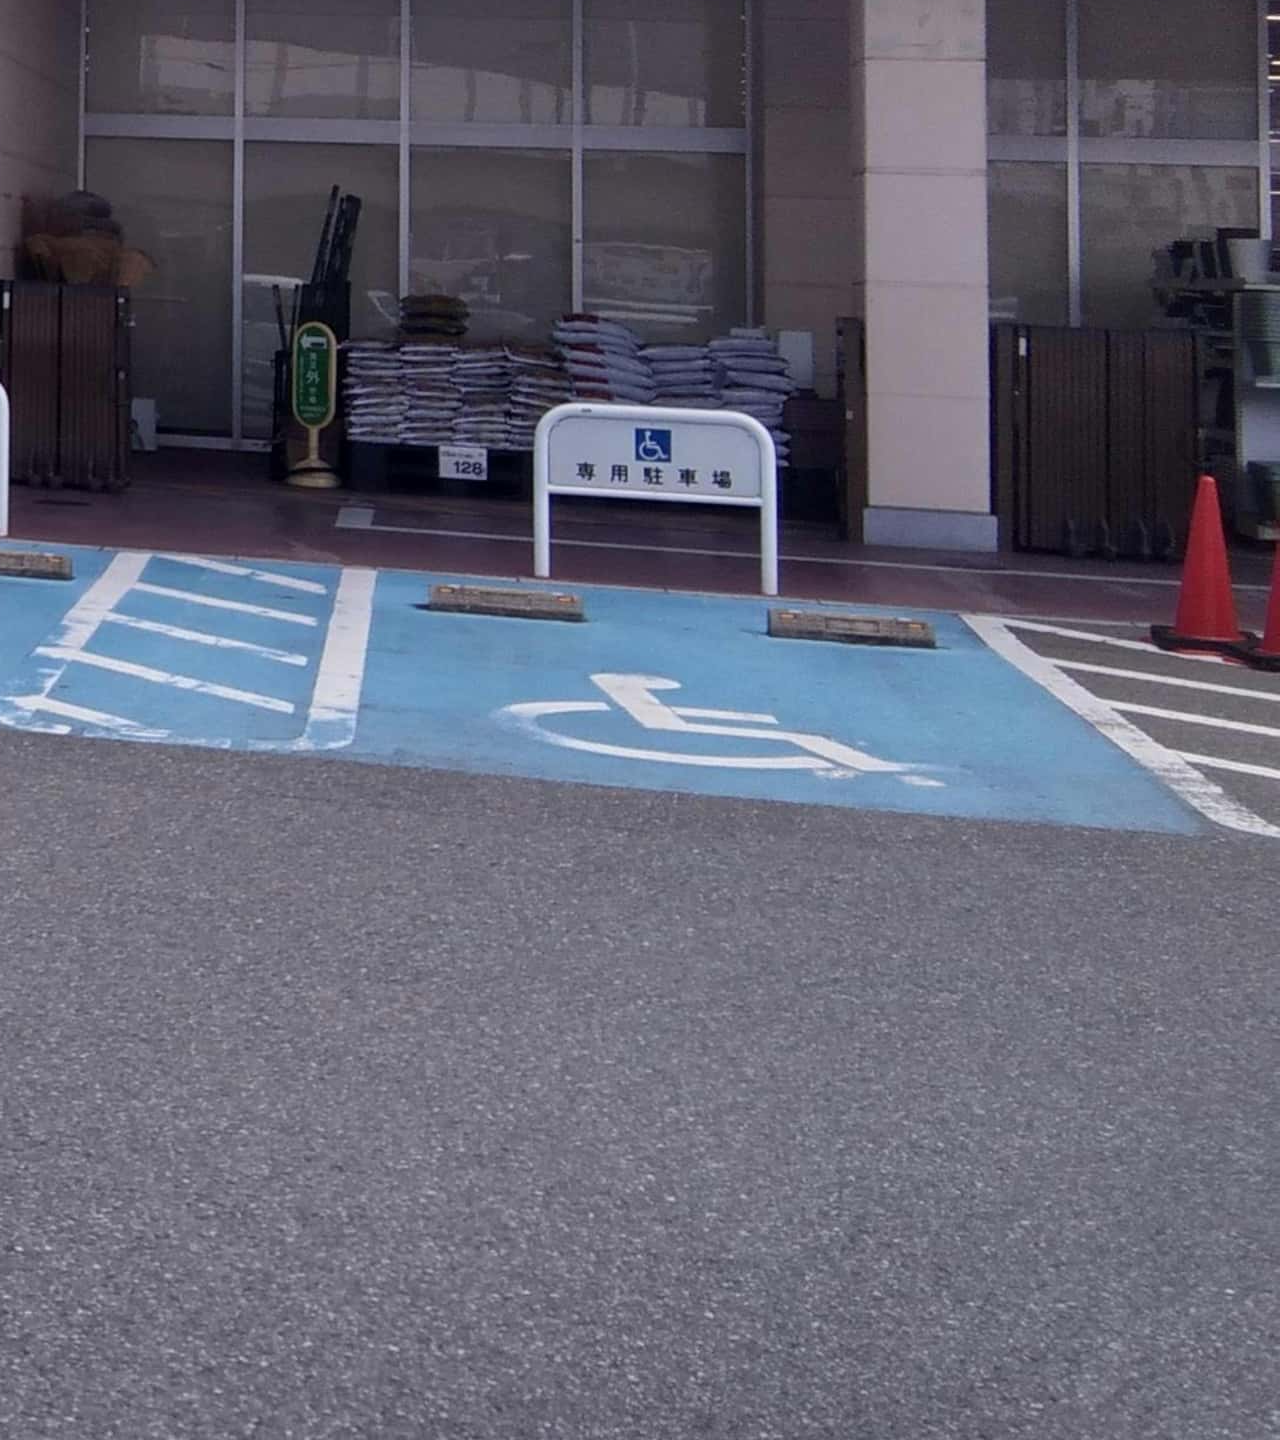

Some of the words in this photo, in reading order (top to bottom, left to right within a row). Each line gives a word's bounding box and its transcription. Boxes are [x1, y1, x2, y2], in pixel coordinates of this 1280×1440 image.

[453, 461, 482, 476] 128
[576, 462, 732, 489] 専用駐車場
